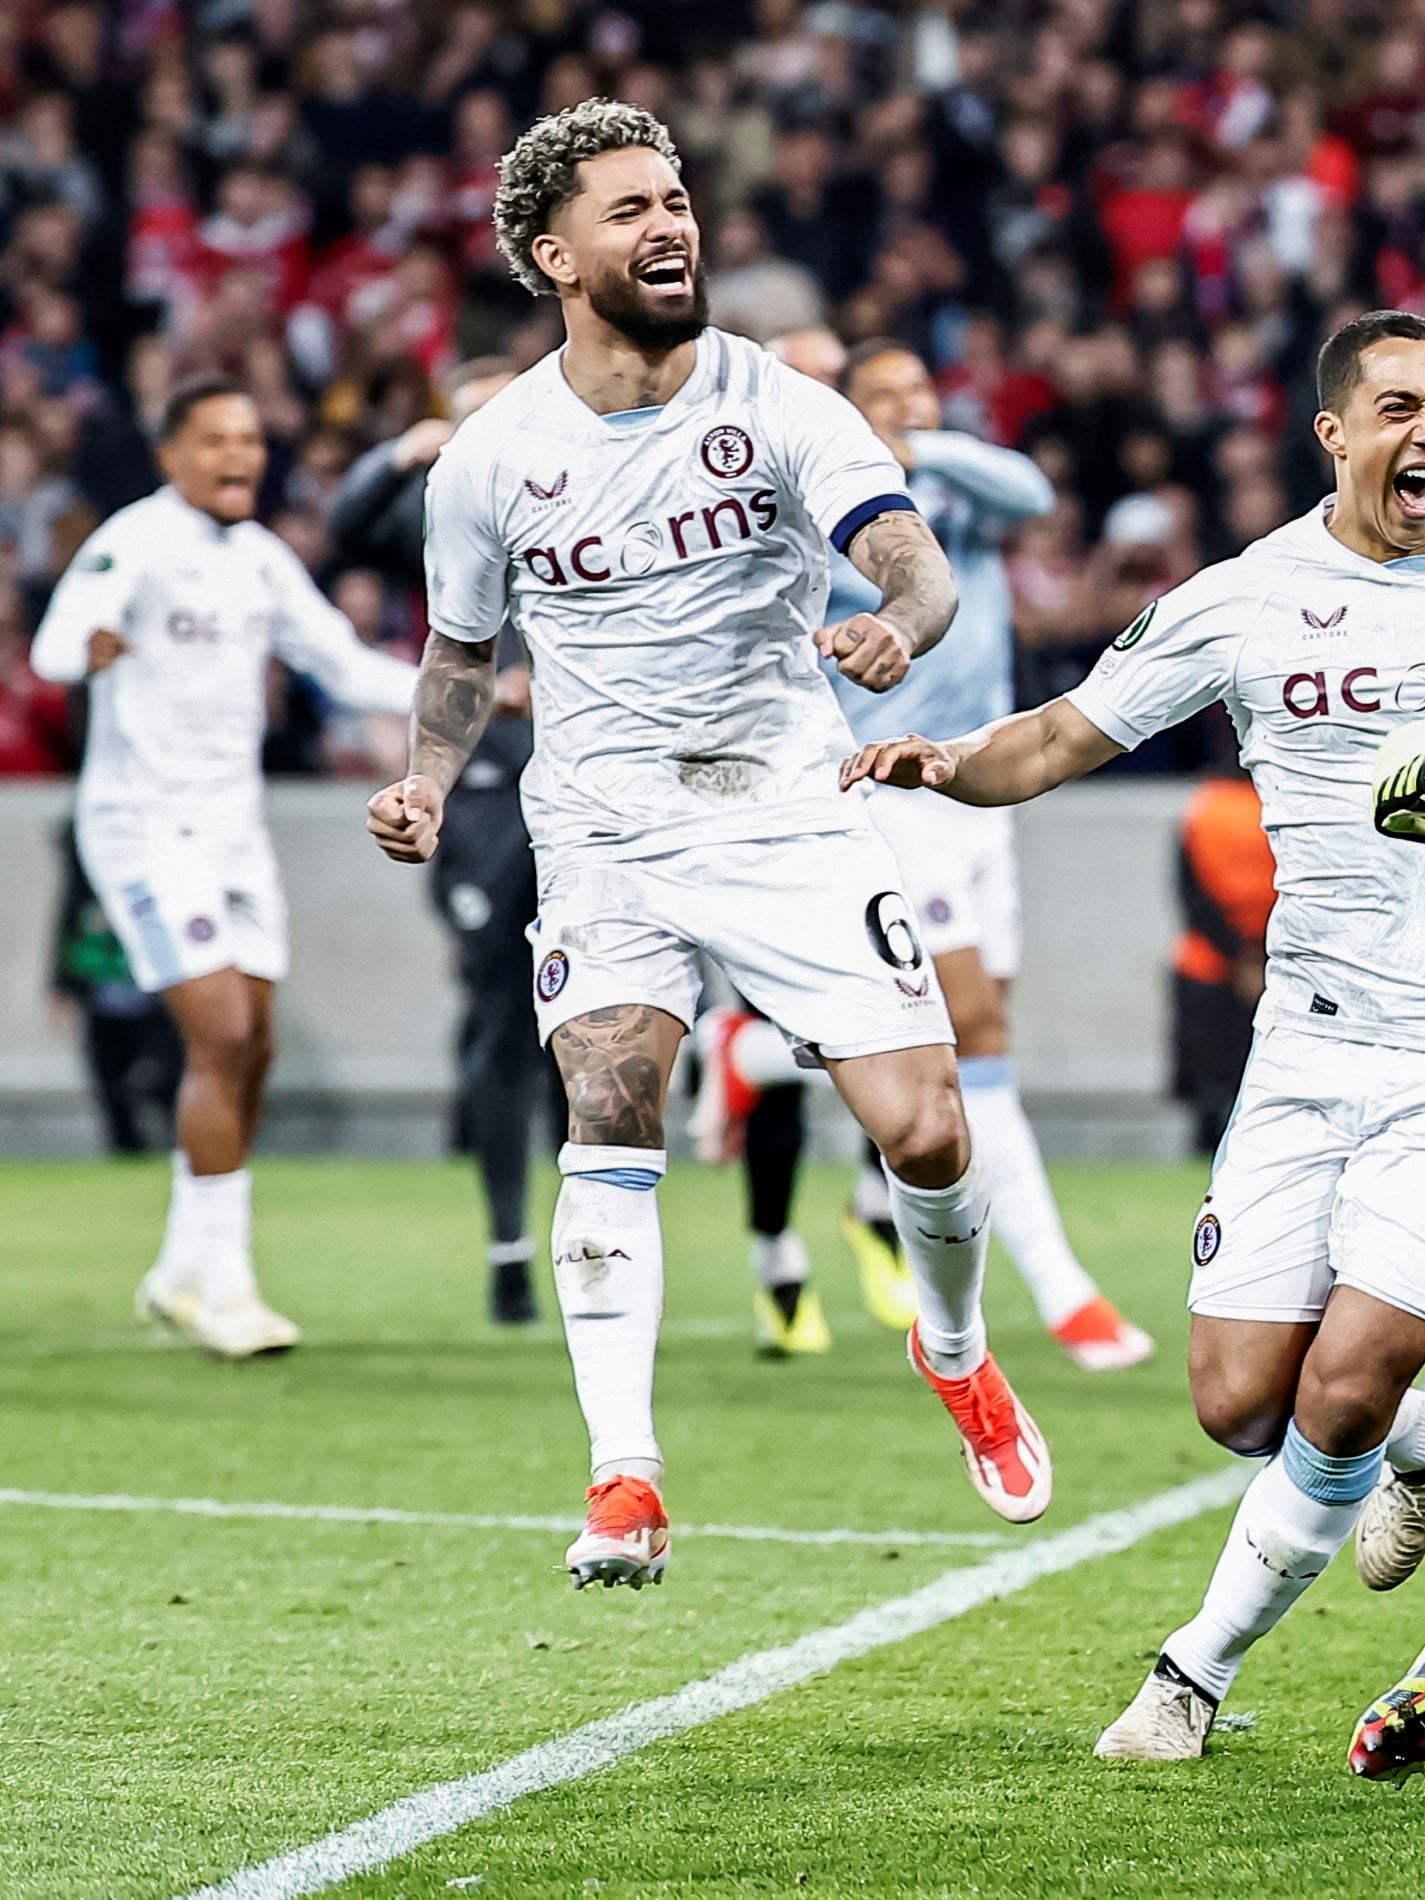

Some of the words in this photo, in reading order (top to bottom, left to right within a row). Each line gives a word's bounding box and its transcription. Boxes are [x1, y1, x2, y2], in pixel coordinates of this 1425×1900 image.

[523, 489, 777, 586] acorns
[1302, 630, 1348, 641] CASTORE
[865, 891, 923, 972] 6
[555, 1247, 632, 1266] VILLA
